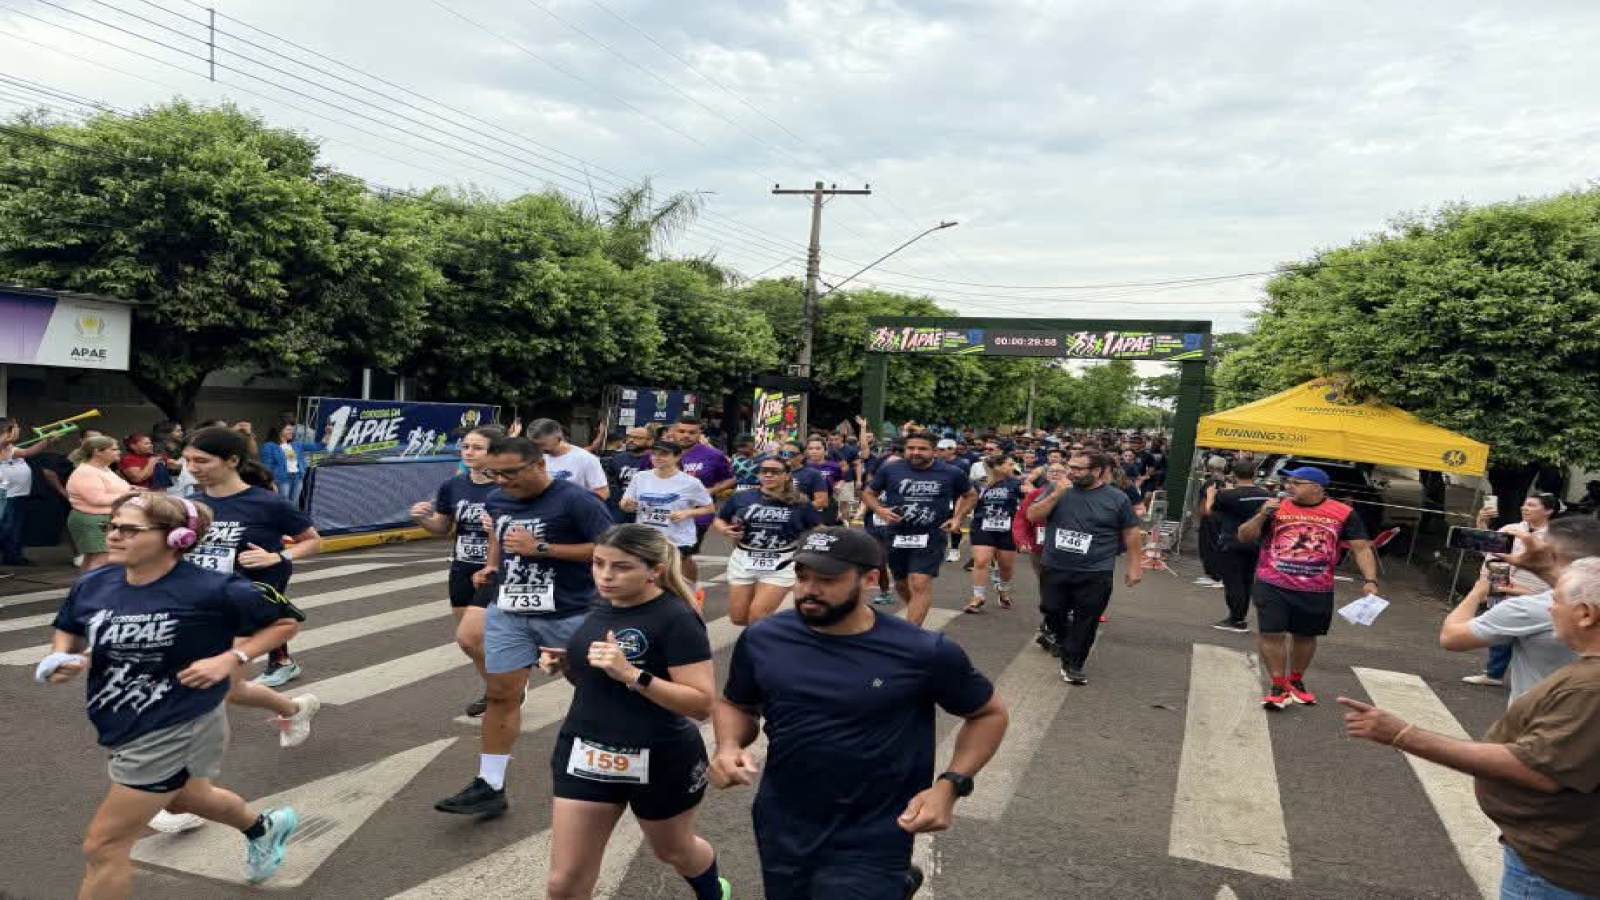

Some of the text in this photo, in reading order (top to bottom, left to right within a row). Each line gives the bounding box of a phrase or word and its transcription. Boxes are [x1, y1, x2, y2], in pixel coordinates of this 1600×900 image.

[909, 332, 943, 347] APAE
[1111, 336, 1153, 353] APAE
[71, 346, 107, 358] APAE
[342, 416, 405, 447] APAE
[202, 527, 248, 541] PAE
[510, 594, 542, 607] 733
[99, 619, 180, 646] APAE
[585, 749, 629, 772] 159
